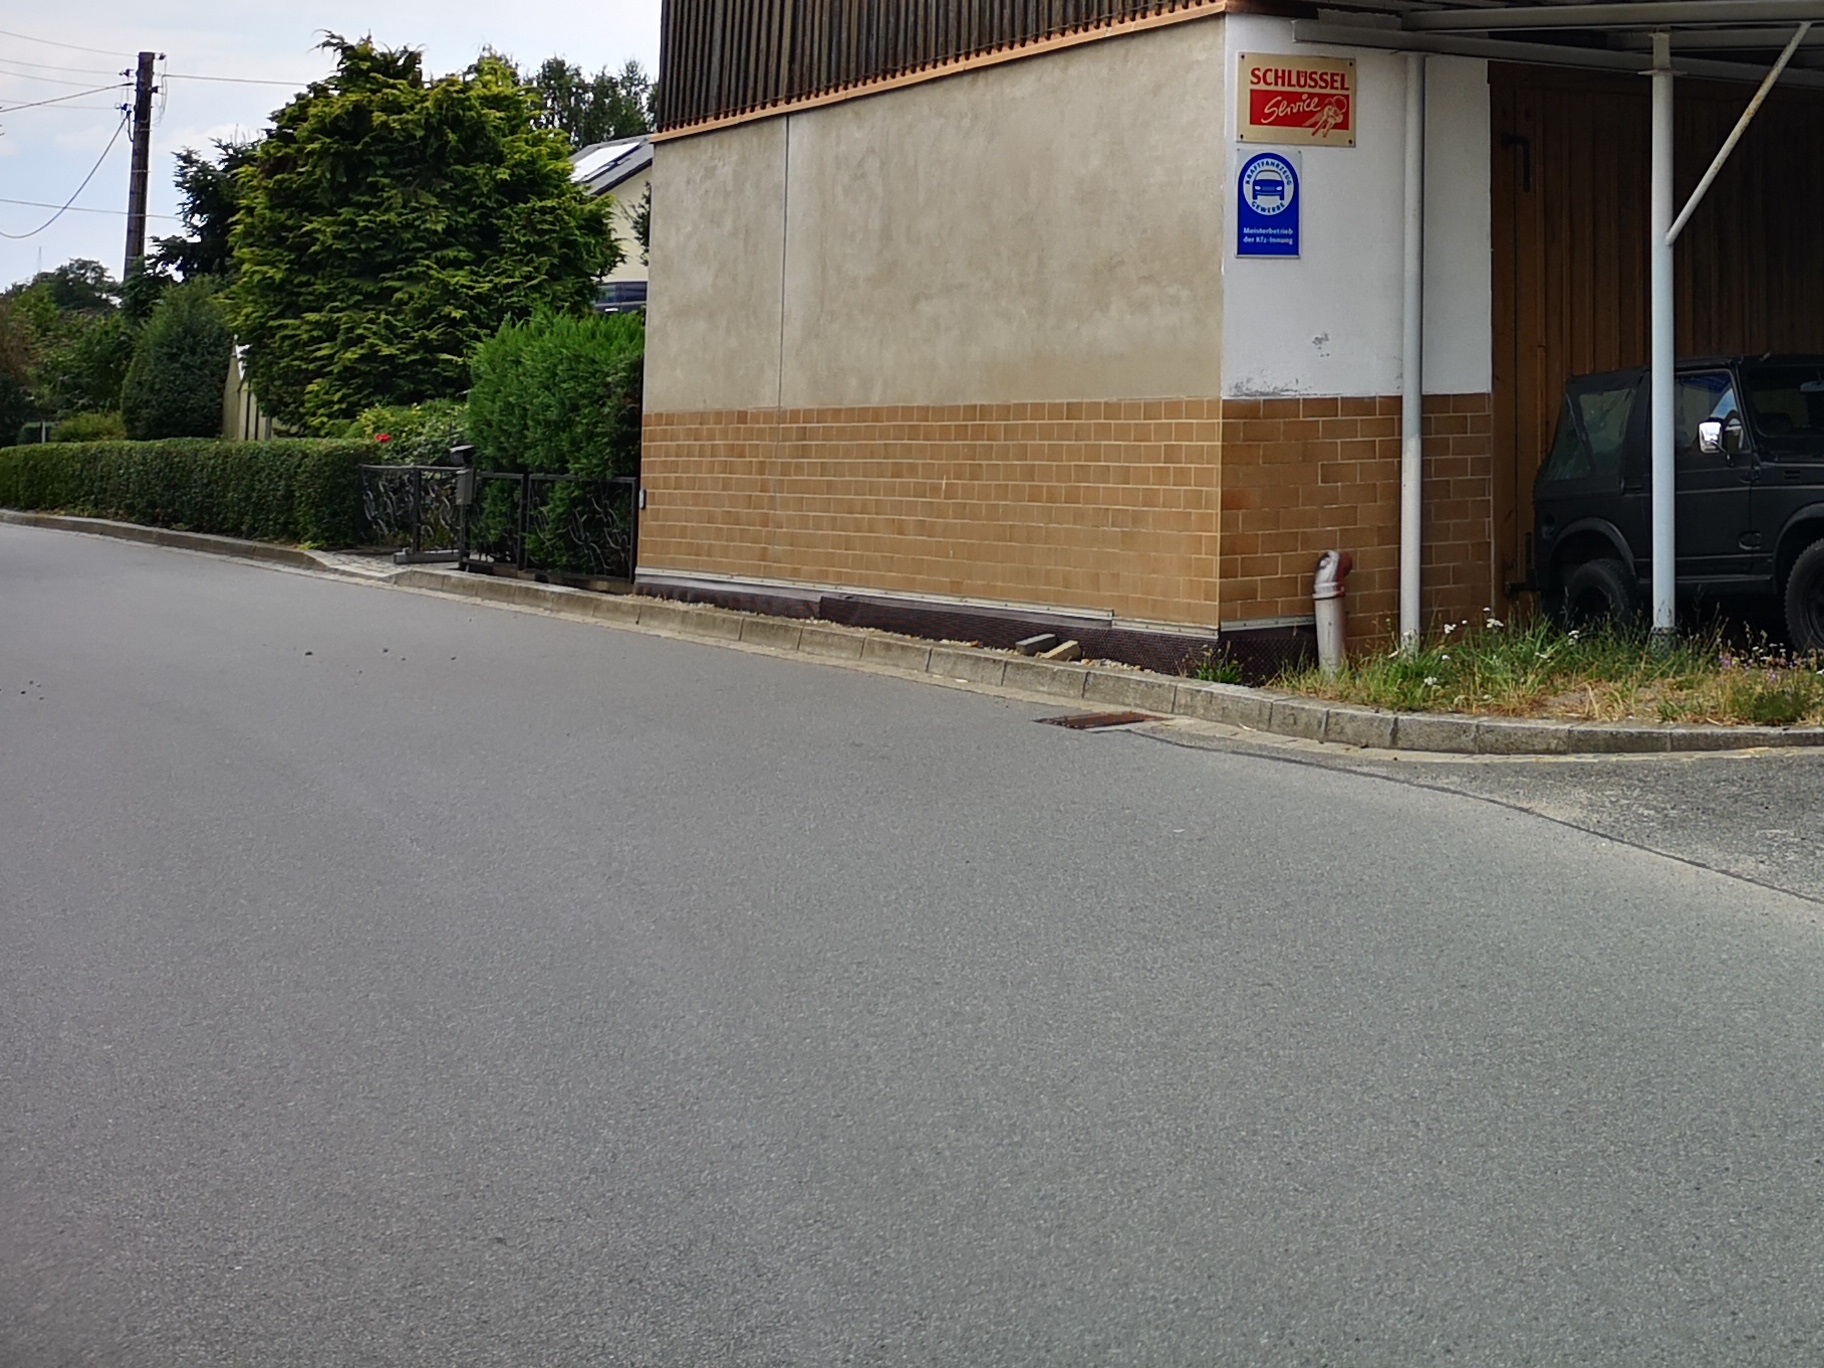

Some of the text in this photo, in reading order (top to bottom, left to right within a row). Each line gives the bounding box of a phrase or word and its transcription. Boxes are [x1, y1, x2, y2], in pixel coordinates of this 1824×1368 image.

[1249, 67, 1351, 91] SCHLÜSSEL
[1260, 93, 1321, 124] Service
[1244, 160, 1292, 185] KRAFTFAHRZEUG
[1251, 200, 1285, 214] GEWERBE
